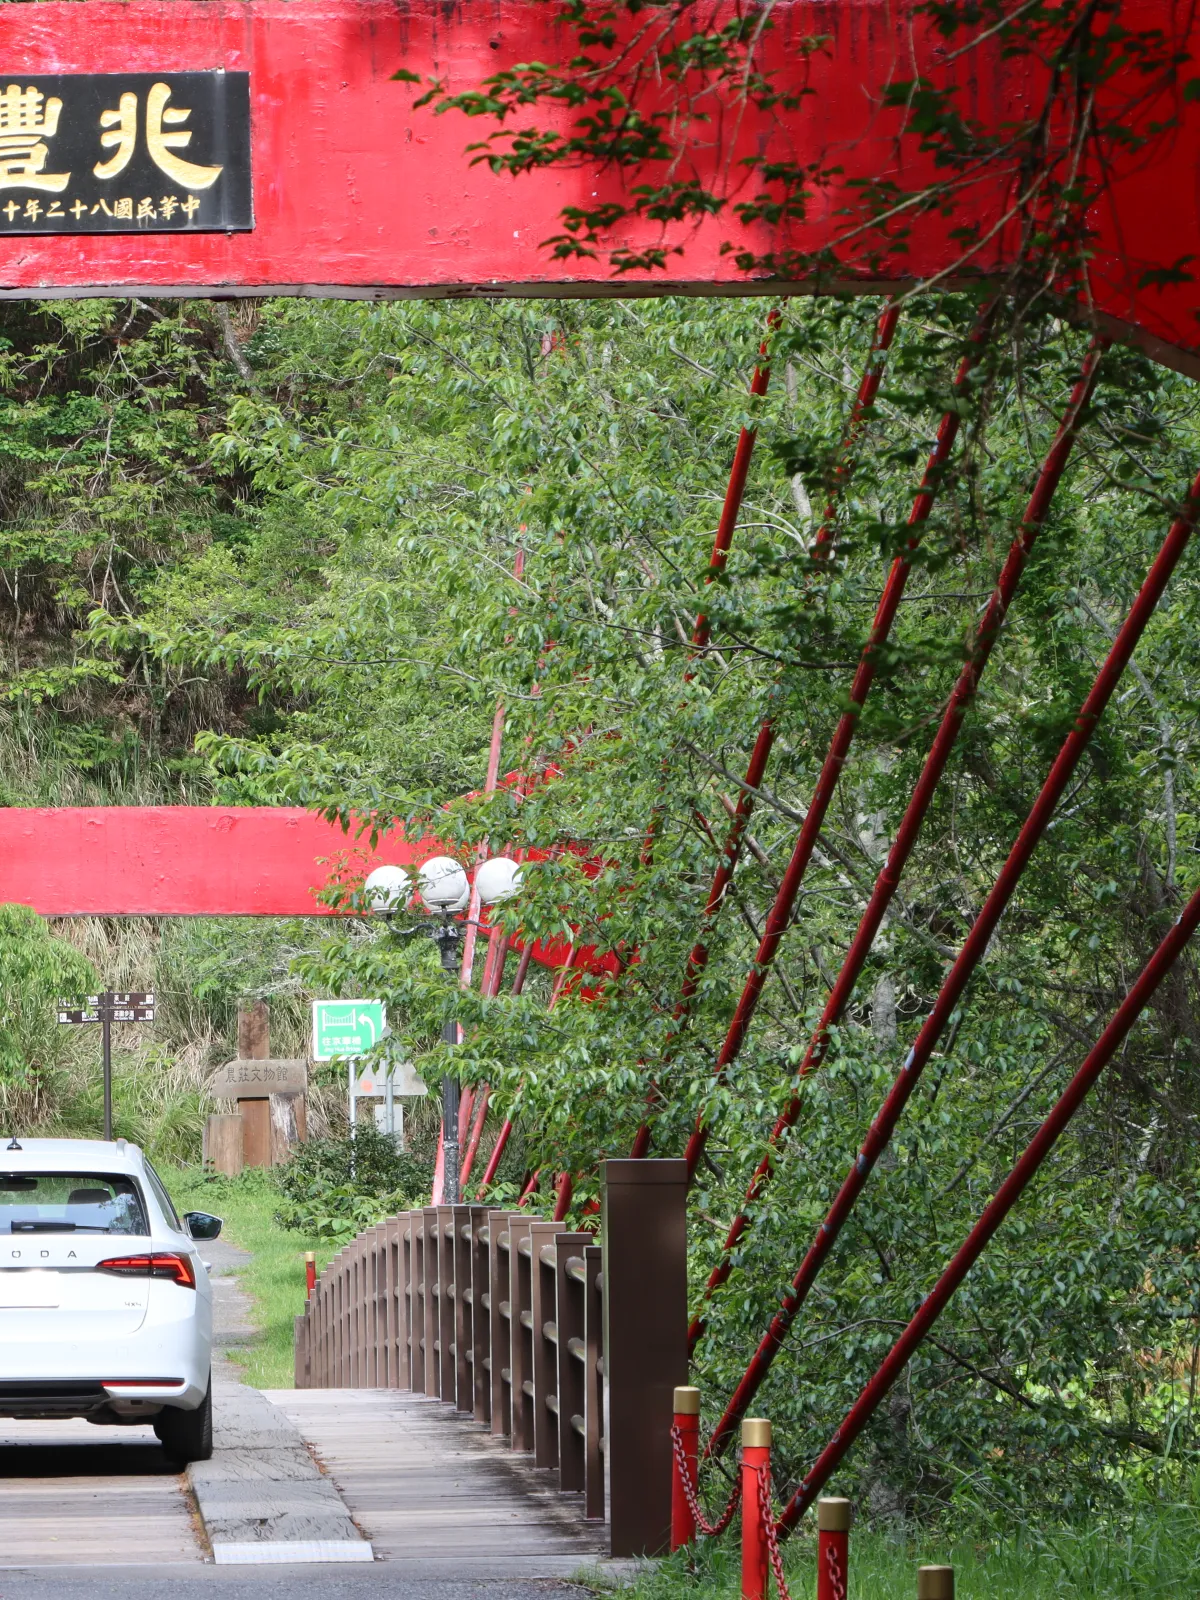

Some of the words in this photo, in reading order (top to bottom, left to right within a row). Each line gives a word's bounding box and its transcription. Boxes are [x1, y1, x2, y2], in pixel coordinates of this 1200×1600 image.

[225, 1066, 288, 1083] 農莊文物館
